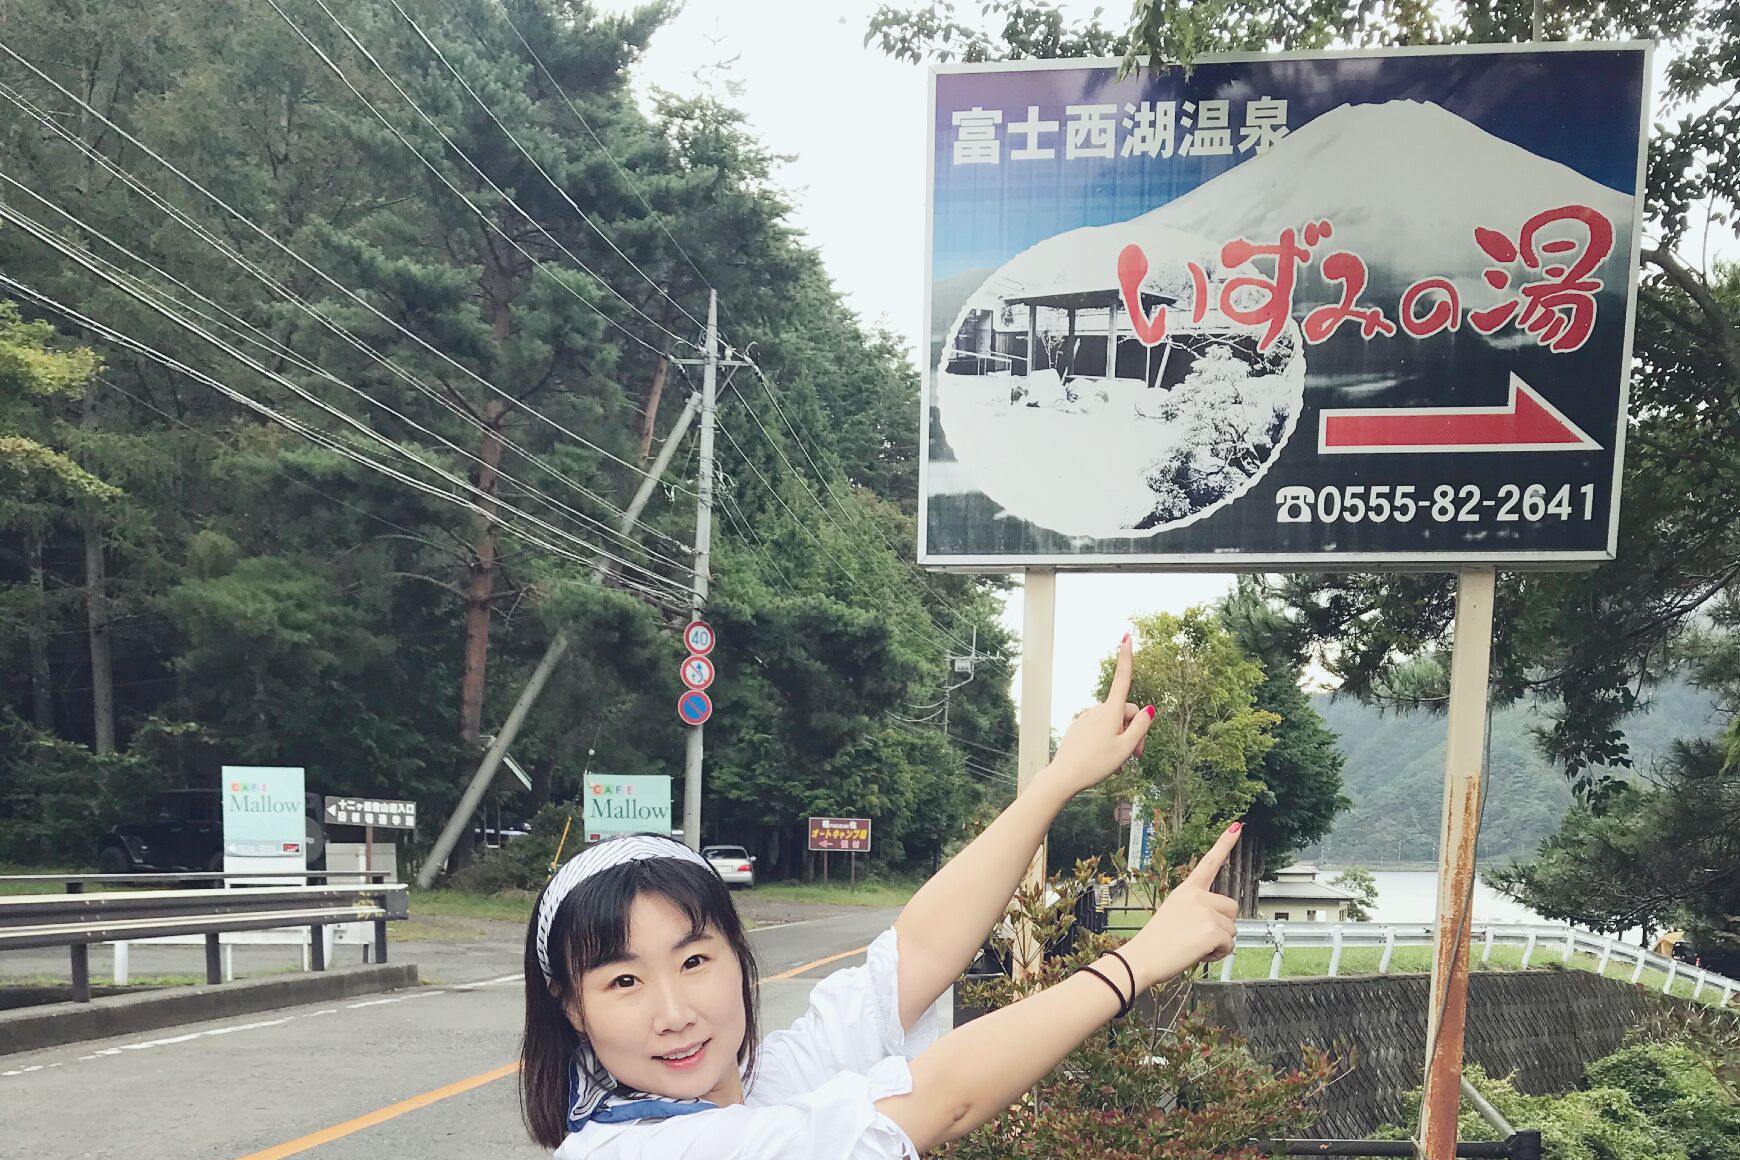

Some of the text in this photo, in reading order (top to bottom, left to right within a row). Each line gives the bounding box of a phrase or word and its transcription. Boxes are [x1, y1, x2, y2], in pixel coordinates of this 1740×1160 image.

[951, 95, 1292, 166] 富士西湖温泉
[1116, 204, 1615, 354] いずみの湯
[1317, 482, 1595, 524] 0555-82-2641
[691, 631, 709, 646] 40
[231, 783, 268, 792] CAFE
[592, 785, 634, 795] CAFE
[229, 794, 302, 813] Mallow
[591, 798, 669, 820] Mallow
